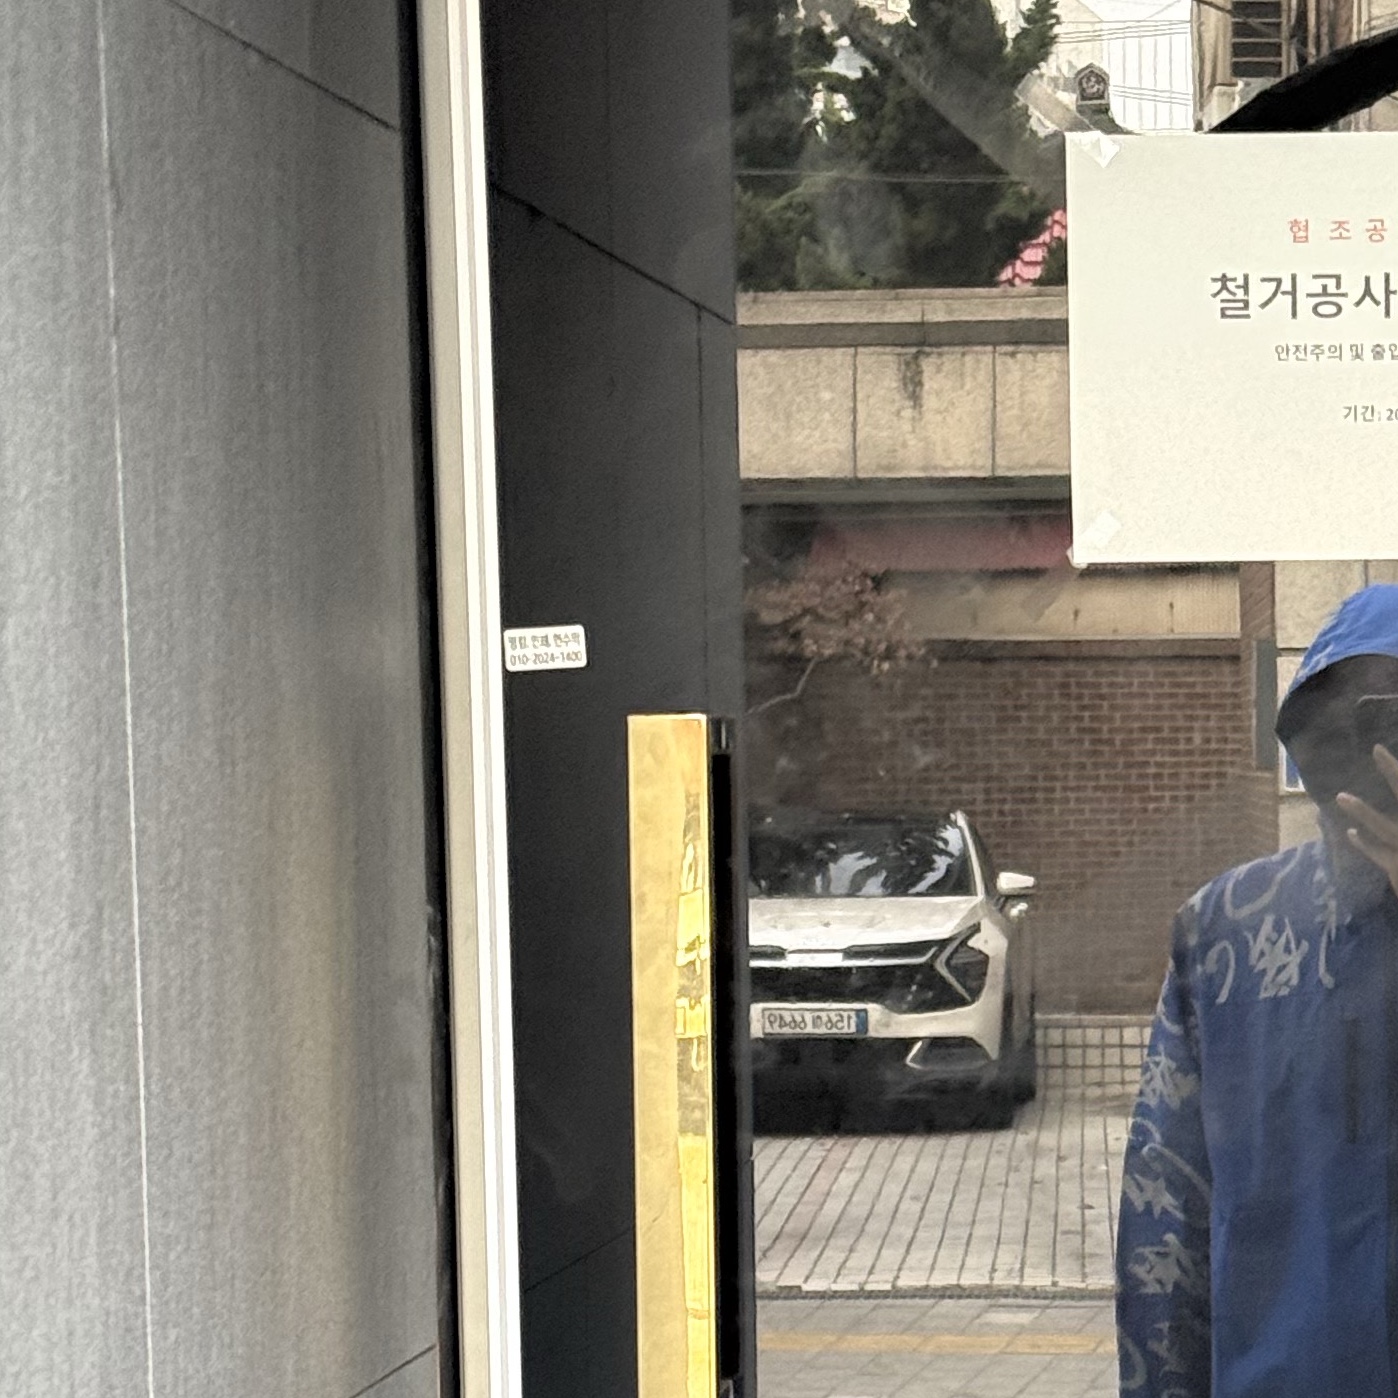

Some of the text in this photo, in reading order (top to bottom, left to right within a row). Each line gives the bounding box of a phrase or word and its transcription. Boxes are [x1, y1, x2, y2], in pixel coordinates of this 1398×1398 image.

[1210, 271, 1397, 320] 철거공사
[1274, 342, 1343, 361] 안전주의
[1349, 343, 1365, 361] 및
